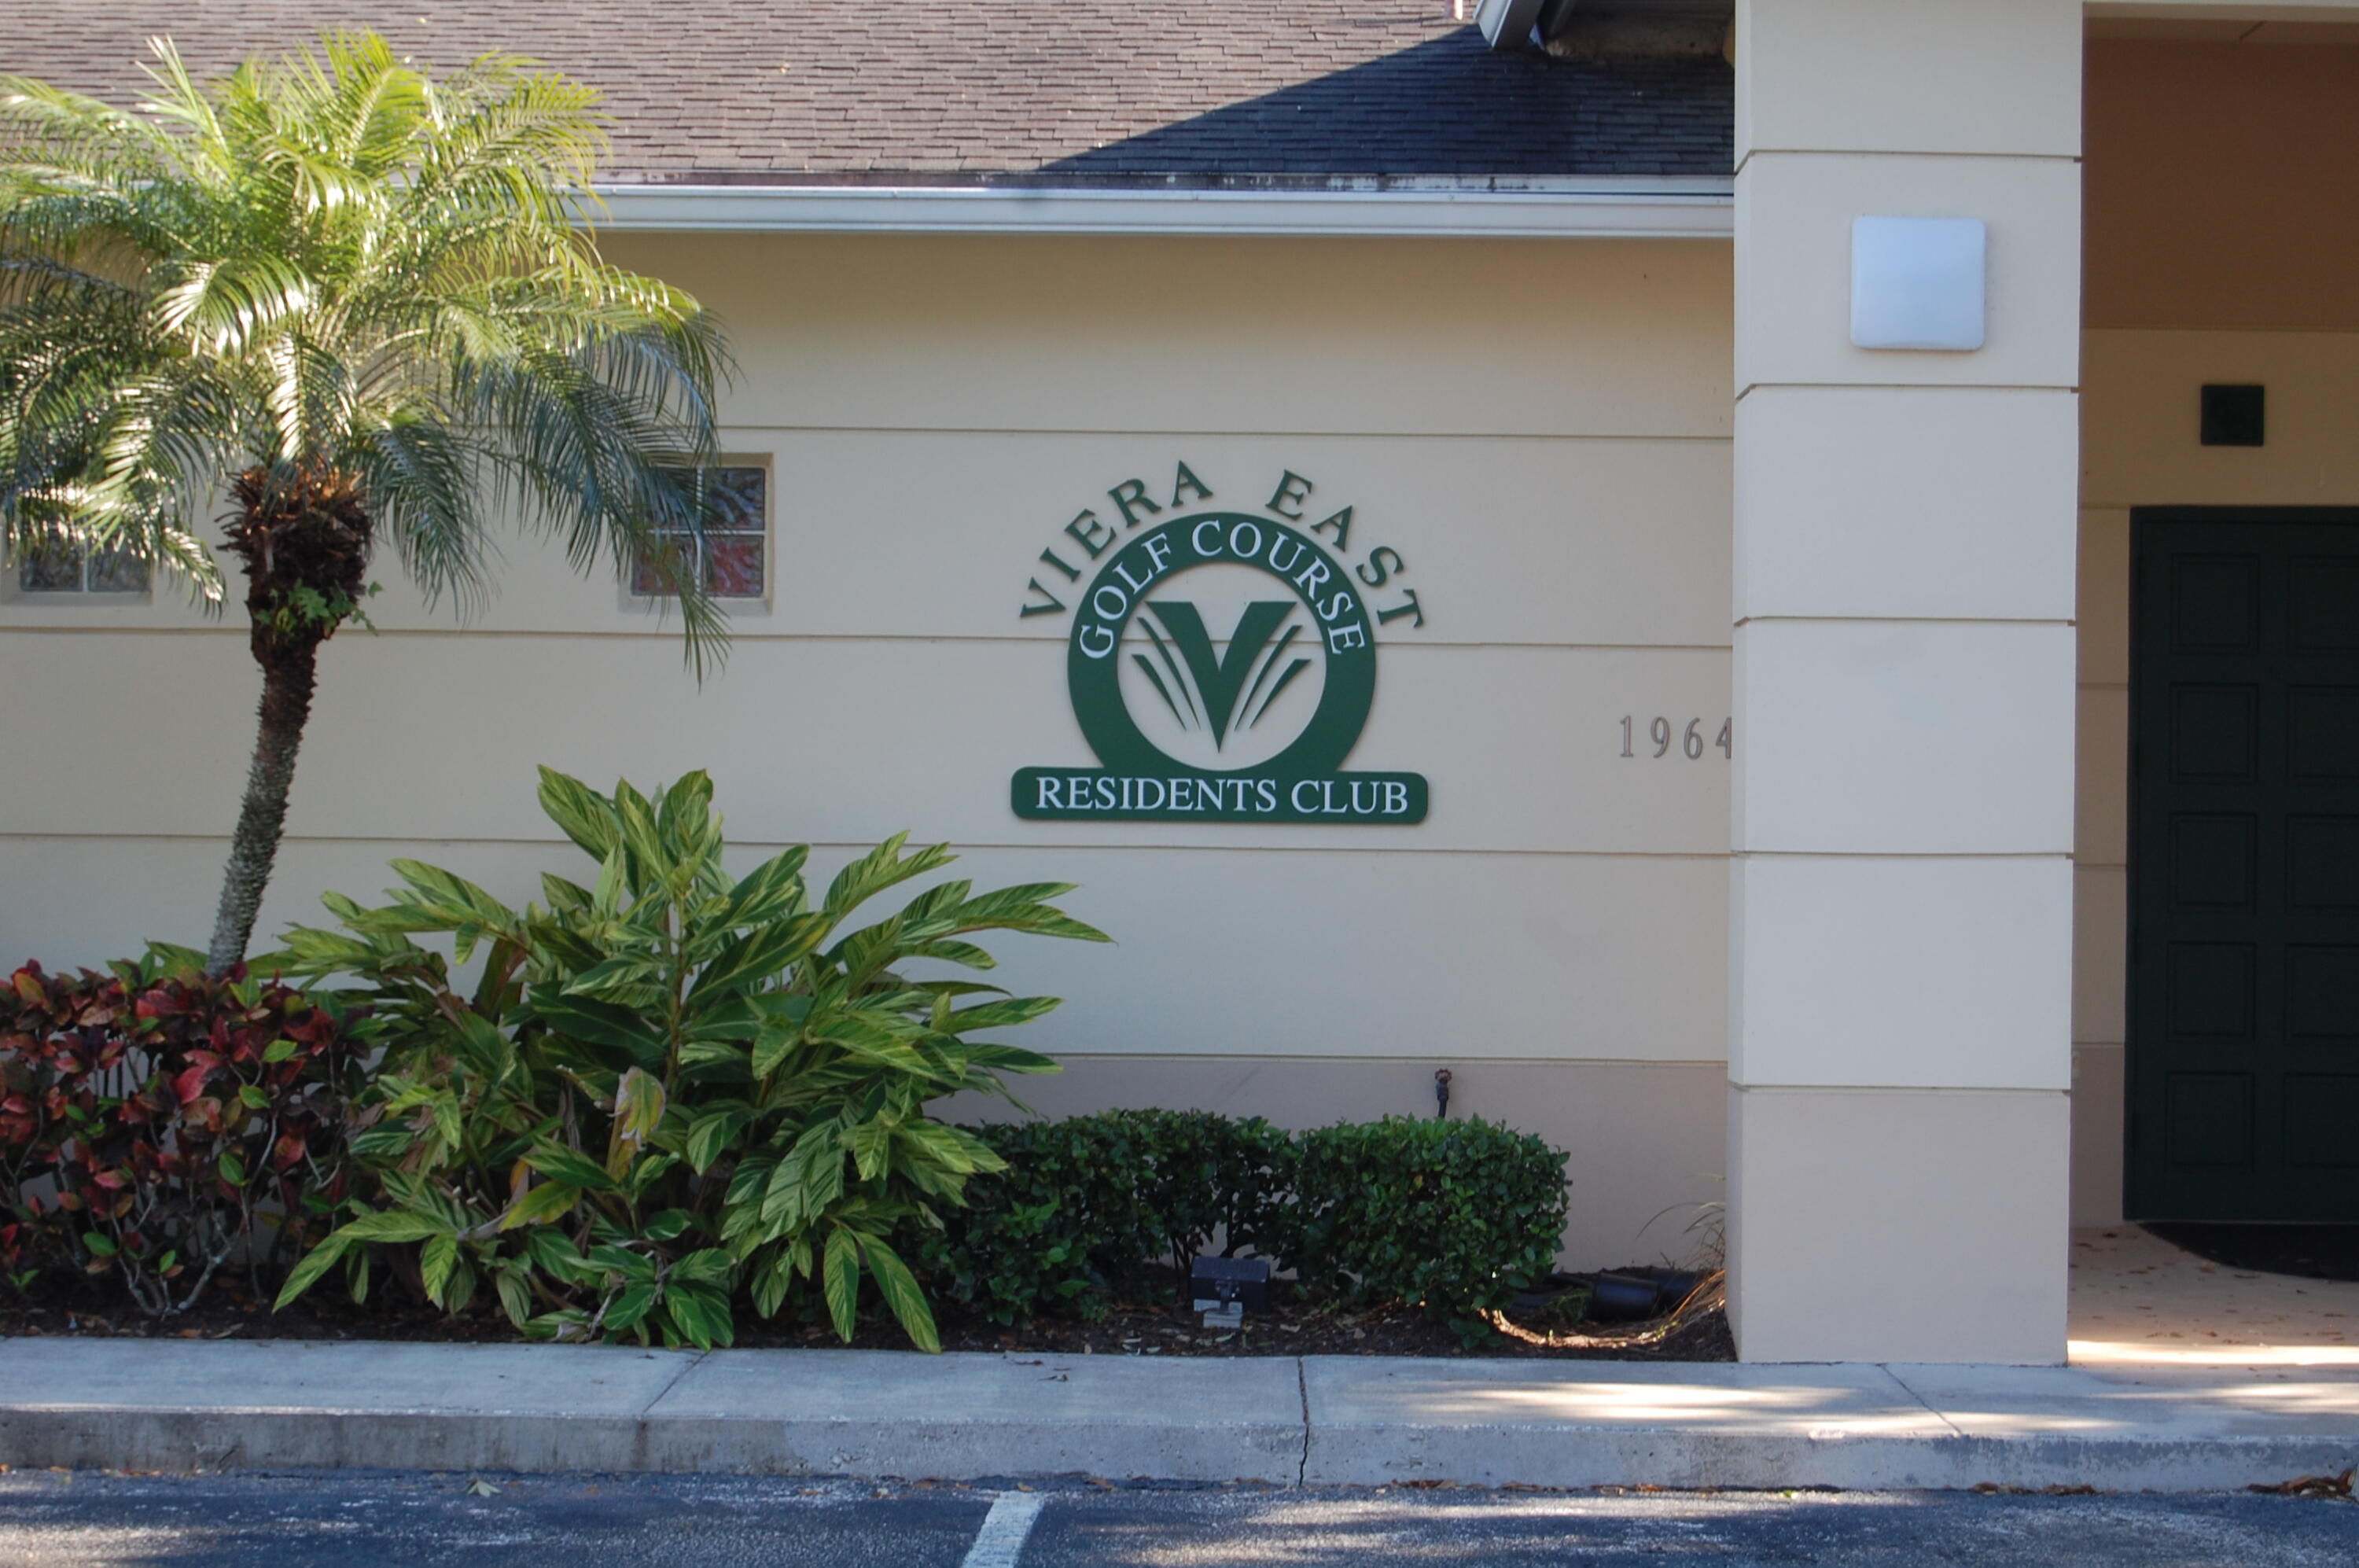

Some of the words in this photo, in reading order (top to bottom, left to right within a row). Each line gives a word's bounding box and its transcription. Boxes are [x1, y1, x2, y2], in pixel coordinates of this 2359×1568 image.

[1020, 459, 1213, 620] VIERA
[1265, 469, 1424, 628] EAST
[1079, 532, 1172, 659] GOLF
[1192, 519, 1365, 654] COURSE
[1620, 715, 1732, 760] 1964
[1036, 776, 1277, 812] RESIDENTS
[1290, 780, 1408, 814] CLUB
